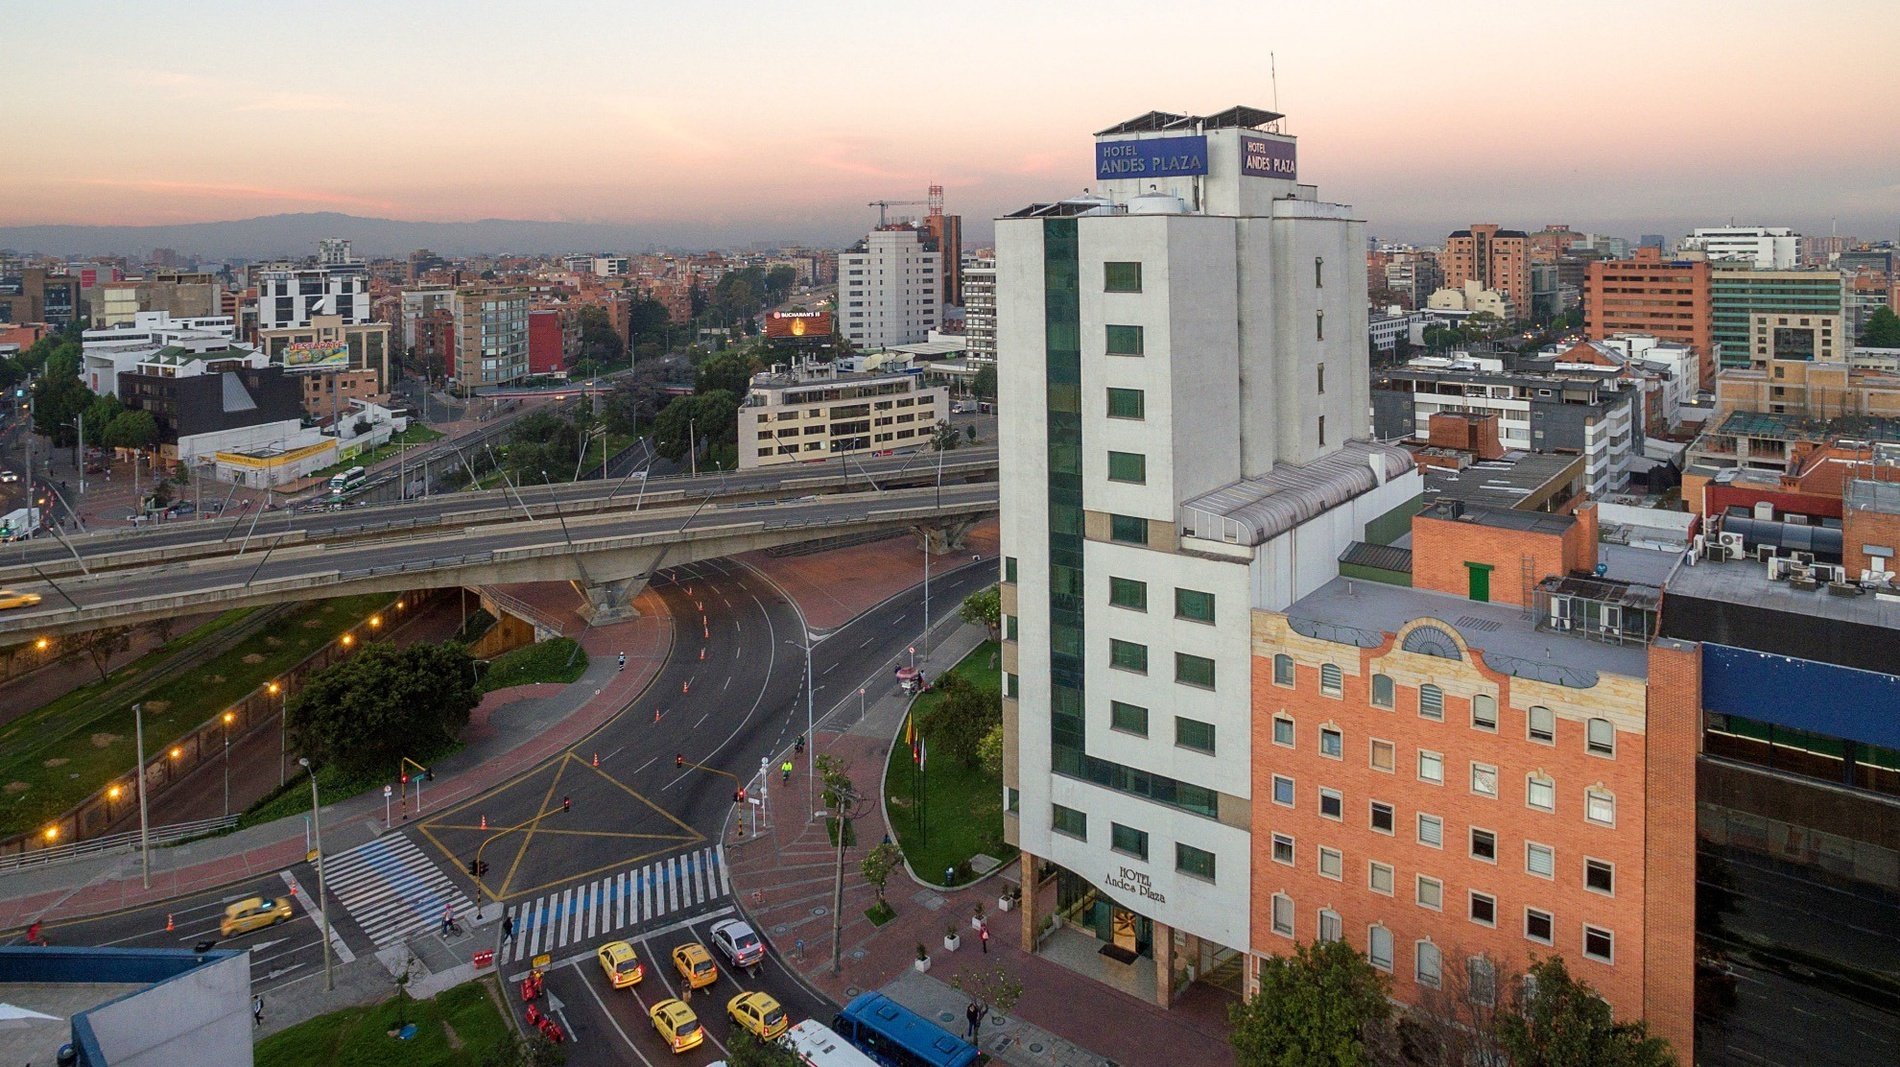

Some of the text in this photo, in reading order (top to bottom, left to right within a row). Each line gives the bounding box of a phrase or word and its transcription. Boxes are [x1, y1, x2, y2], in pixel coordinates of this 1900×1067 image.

[1103, 145, 1138, 157] HOTEL
[1247, 141, 1266, 154] HOTEL
[1100, 155, 1201, 173] ANDES PLAZA
[1246, 155, 1295, 173] ANDES PLAZA
[1120, 866, 1152, 887] HOTEL
[1105, 873, 1166, 904] Andes Plaza
